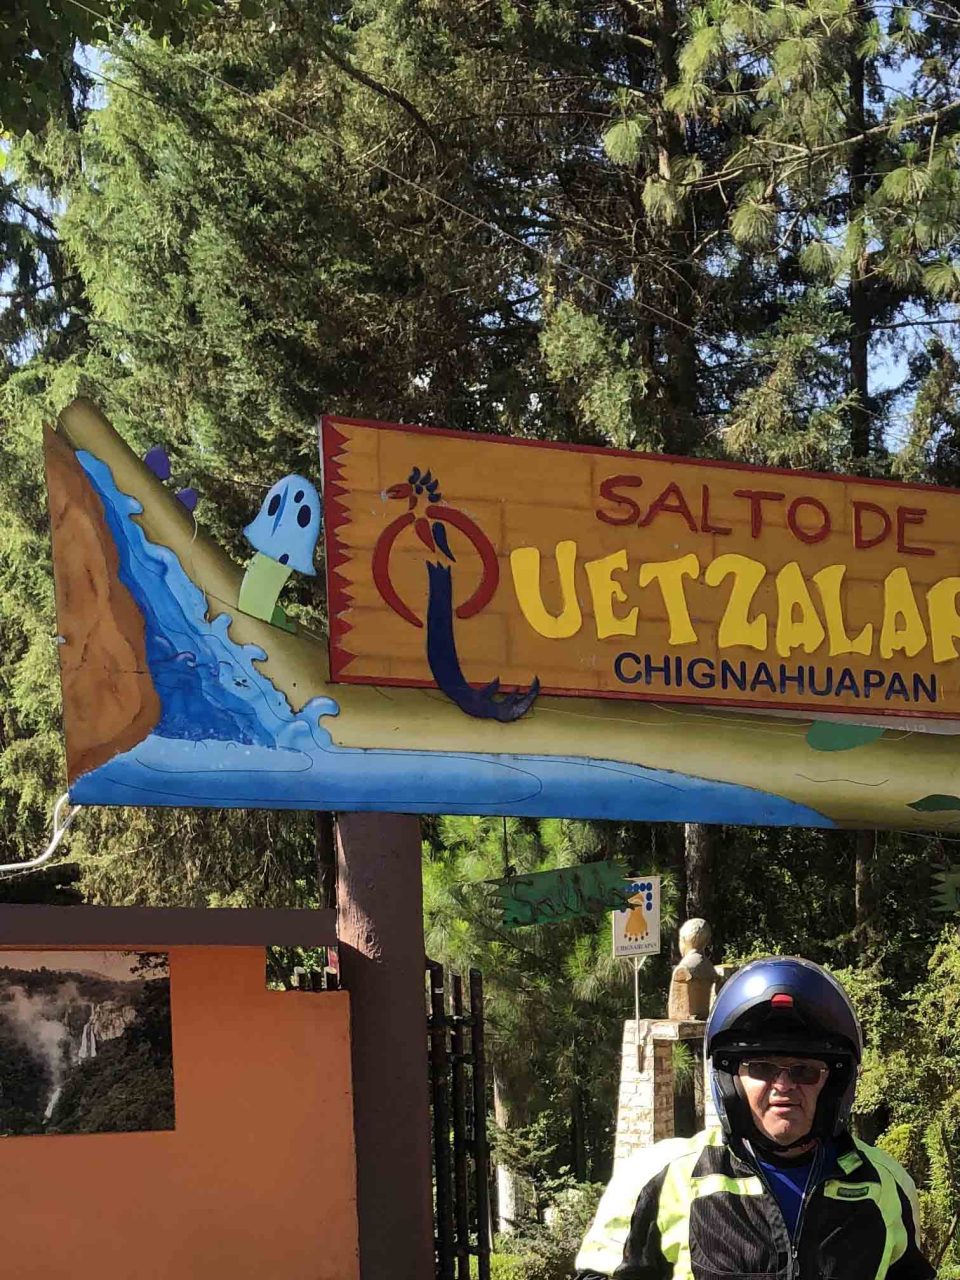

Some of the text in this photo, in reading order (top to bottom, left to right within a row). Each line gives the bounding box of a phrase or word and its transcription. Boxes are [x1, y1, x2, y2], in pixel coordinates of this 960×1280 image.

[595, 475, 936, 557] SALTO DE
[613, 652, 939, 704] CHIGNAHUAPAN
